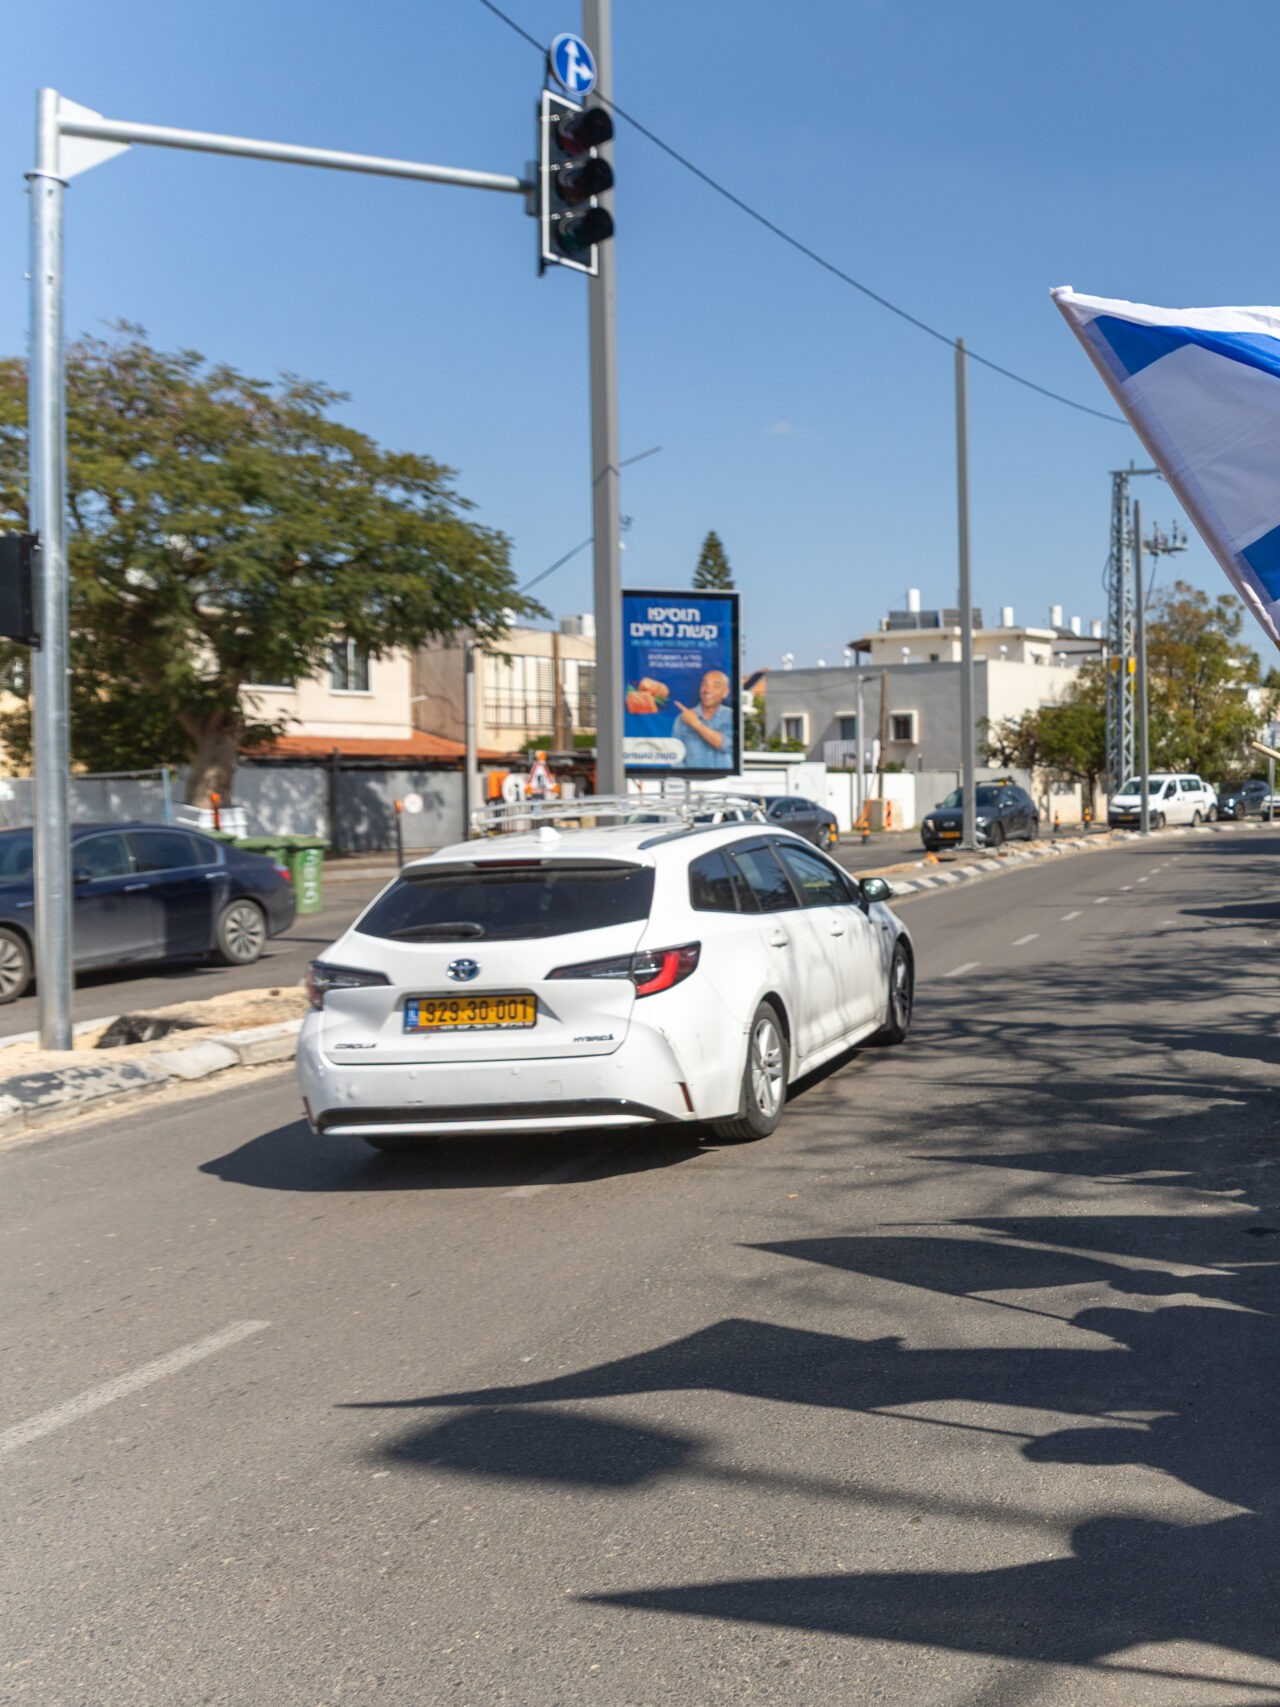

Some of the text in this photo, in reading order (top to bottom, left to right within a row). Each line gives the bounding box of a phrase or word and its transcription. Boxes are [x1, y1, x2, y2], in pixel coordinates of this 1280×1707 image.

[647, 607, 701, 622] תוסיפו
[630, 622, 718, 640] קשת לחיים
